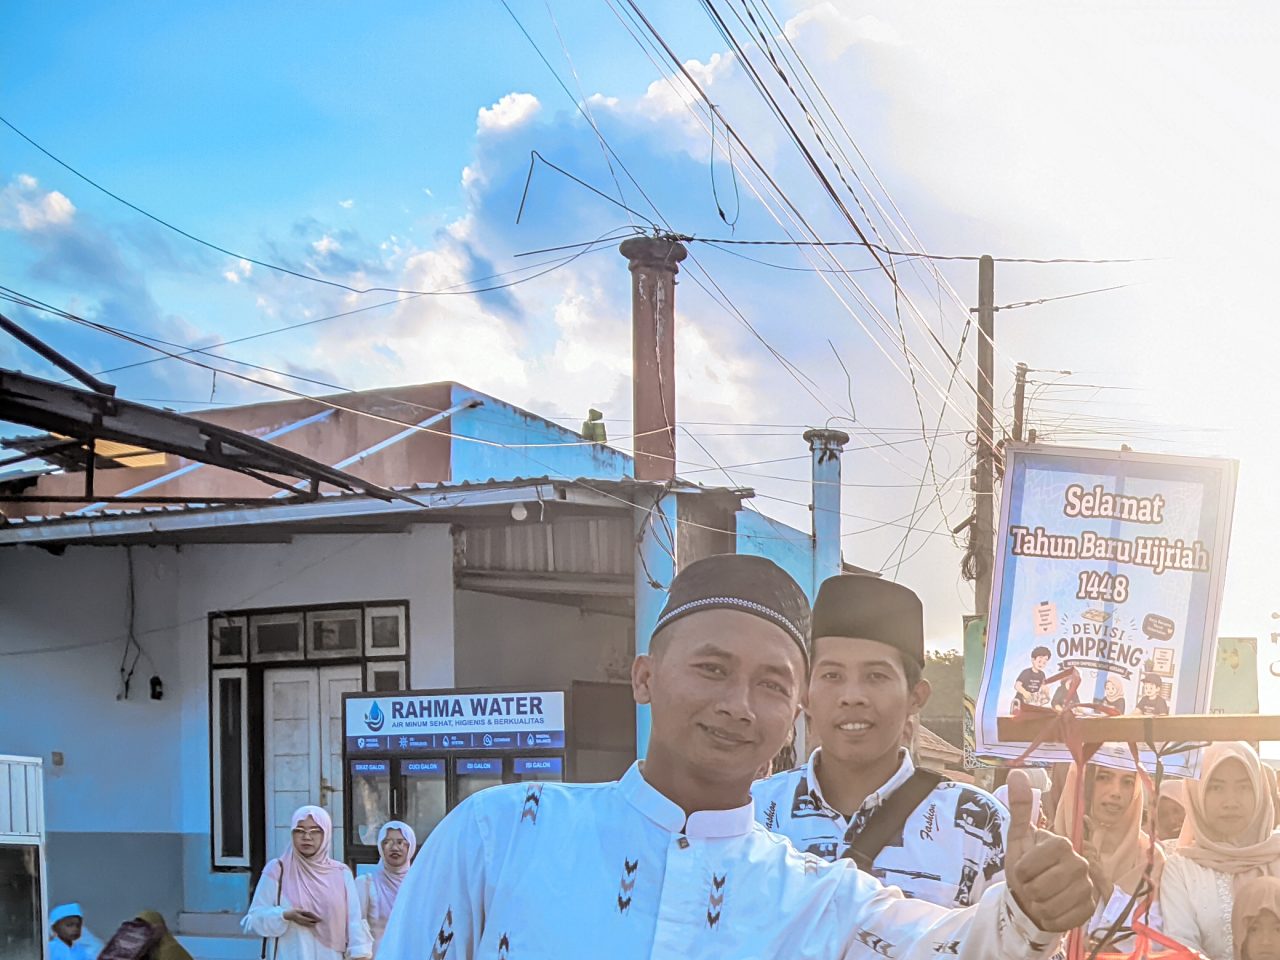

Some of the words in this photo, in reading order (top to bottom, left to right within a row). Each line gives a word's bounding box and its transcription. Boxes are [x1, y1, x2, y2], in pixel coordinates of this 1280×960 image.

[1064, 485, 1165, 523] Selamat
[1010, 526, 1077, 557] Tahun
[1081, 531, 1129, 562] Baru
[1133, 536, 1209, 575] Hijriah
[1077, 571, 1129, 603] 1448
[1072, 623, 1125, 640] DEVISI
[1057, 637, 1143, 667] OMPRENG
[391, 698, 464, 719] RAHMA
[469, 696, 543, 717] WATER
[405, 720, 428, 728] MINUM
[494, 717, 545, 725] BERKUALITAS
[766, 800, 778, 831] ashion
[920, 800, 937, 841] Fashion
